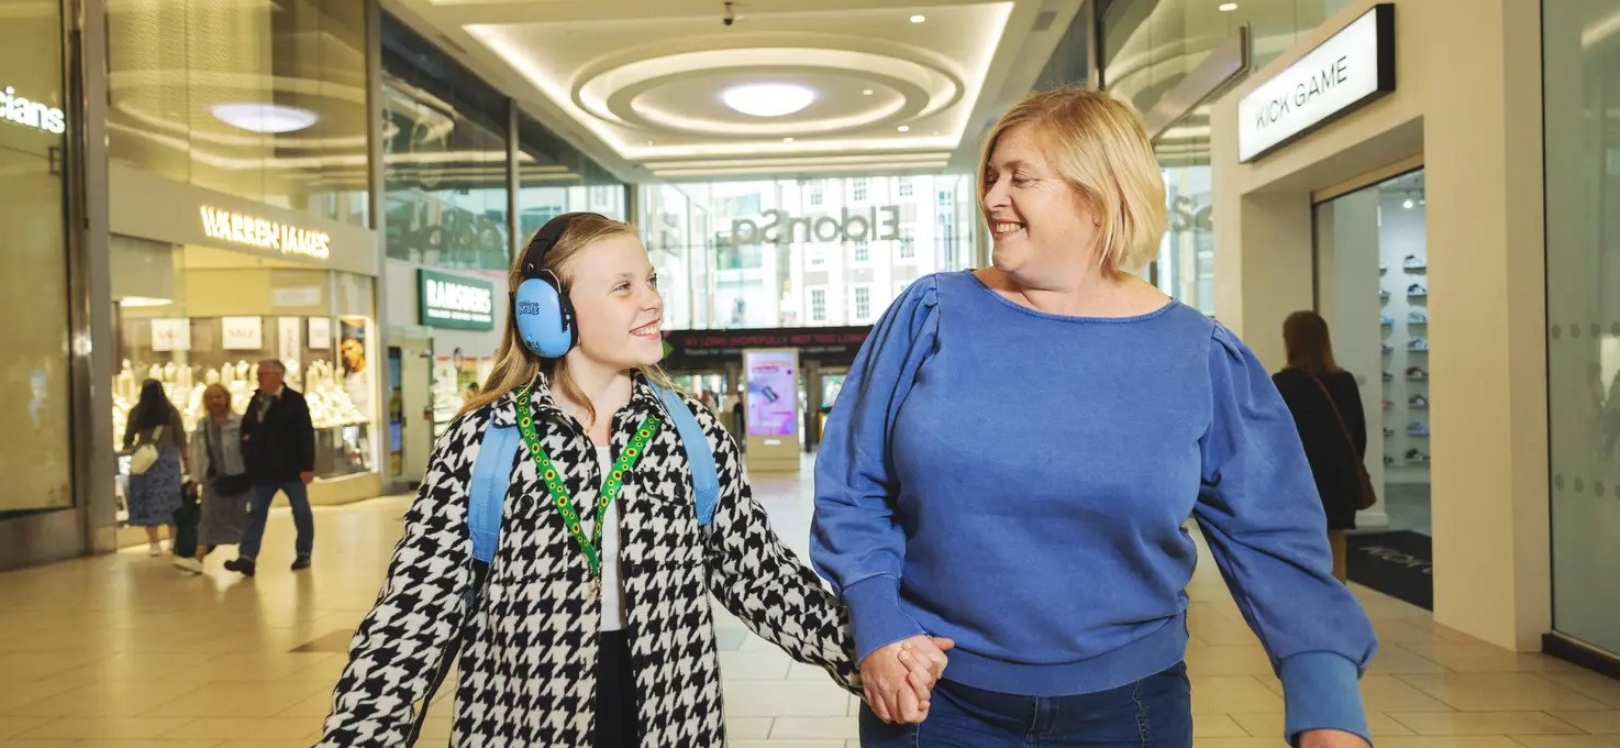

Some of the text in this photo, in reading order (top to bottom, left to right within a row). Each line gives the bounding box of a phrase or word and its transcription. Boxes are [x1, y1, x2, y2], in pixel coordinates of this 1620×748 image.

[1256, 55, 1347, 131] KICK GAME
[199, 205, 330, 259] WARREN JAMES
